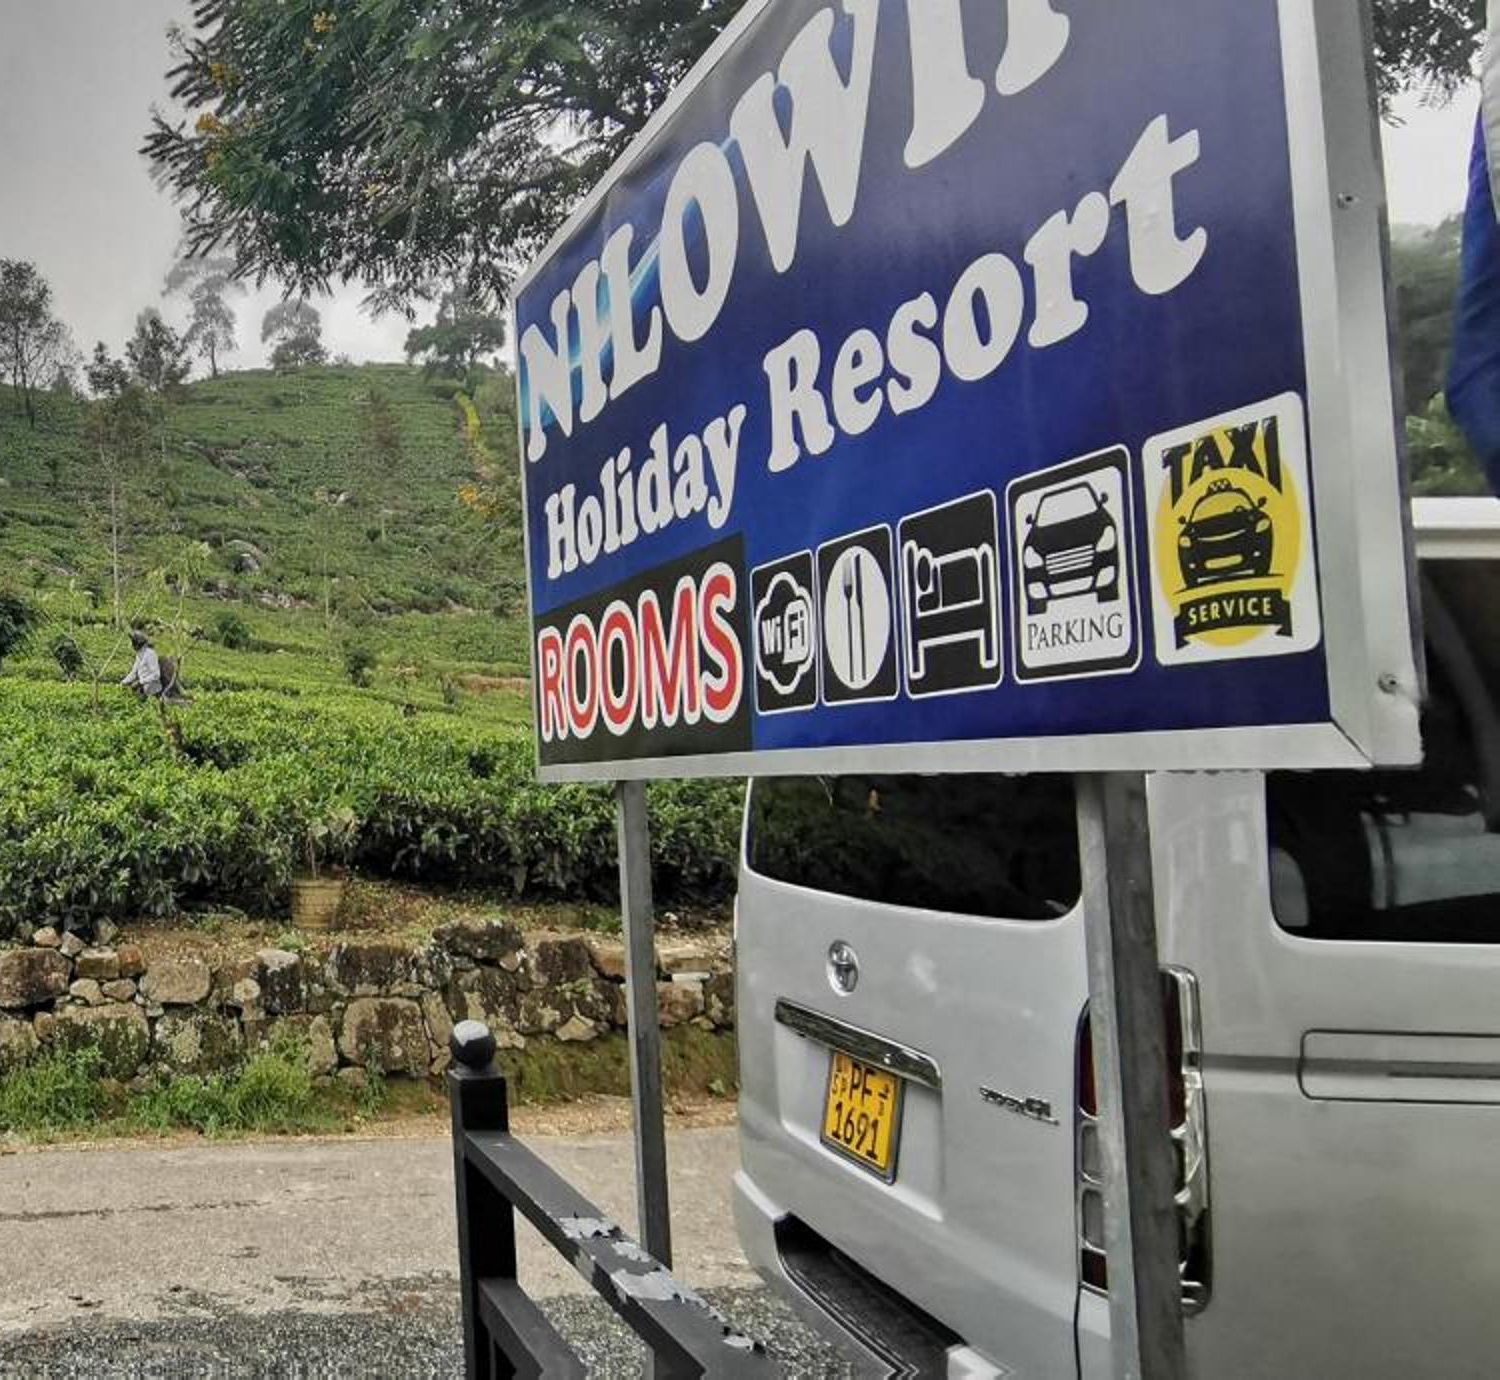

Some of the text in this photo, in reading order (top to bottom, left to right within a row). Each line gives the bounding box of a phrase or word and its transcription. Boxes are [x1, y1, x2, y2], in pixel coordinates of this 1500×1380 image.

[544, 113, 1208, 579] Holiday Resort
[1161, 415, 1283, 509] TAXI
[538, 561, 744, 743] ROOMS
[1187, 597, 1273, 626] SERVICE
[831, 1101, 879, 1161] 1691
